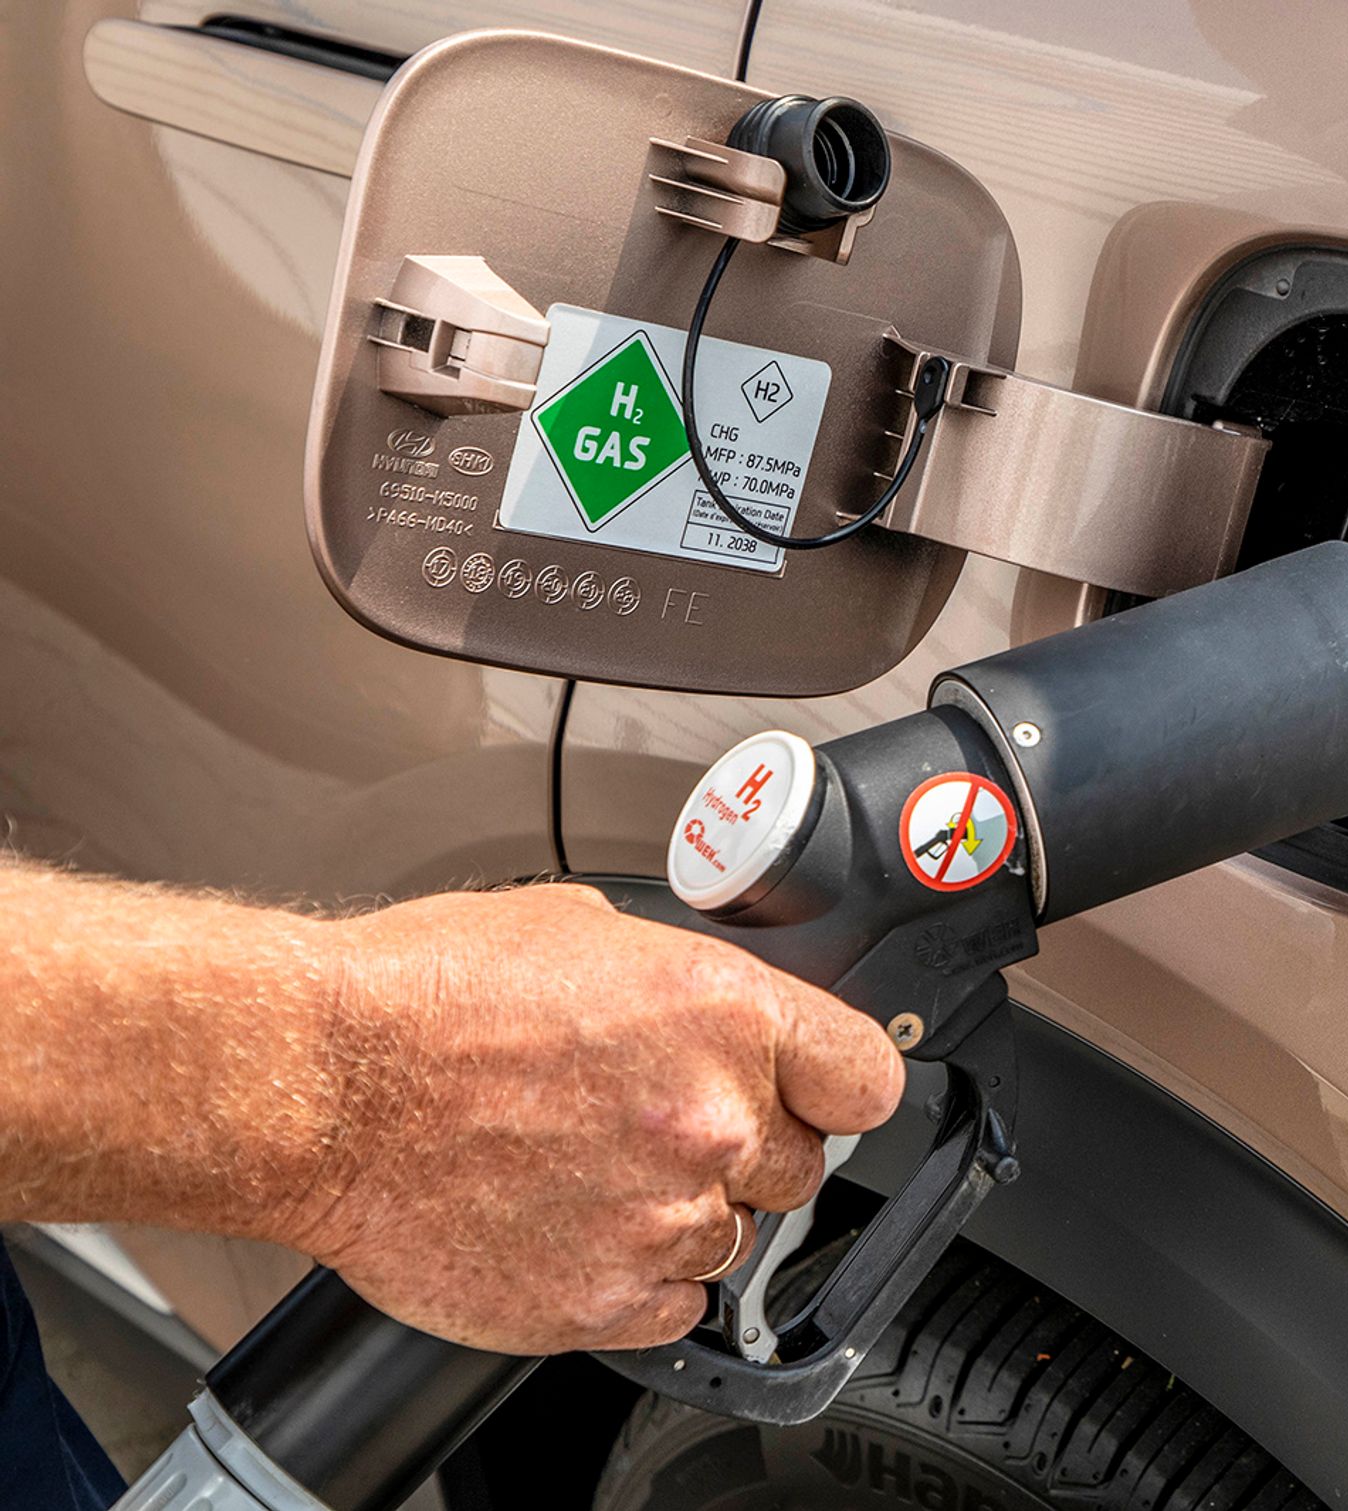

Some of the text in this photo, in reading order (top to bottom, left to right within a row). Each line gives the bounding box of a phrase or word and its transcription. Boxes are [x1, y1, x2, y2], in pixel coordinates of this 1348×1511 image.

[754, 380, 780, 403] H2
[710, 422, 740, 442] CHG
[573, 425, 651, 471] GAS
[705, 445, 737, 463] MFP
[746, 453, 802, 478] 87.5MPa
[372, 453, 440, 479] HYUNDAI
[698, 469, 732, 487] WP
[742, 475, 796, 500] 70.0MPa
[696, 497, 717, 510] Tank
[763, 508, 785, 522] Date
[707, 533, 758, 553] 11. 2038
[703, 786, 739, 826] Hydrogen
[735, 763, 774, 822] H2
